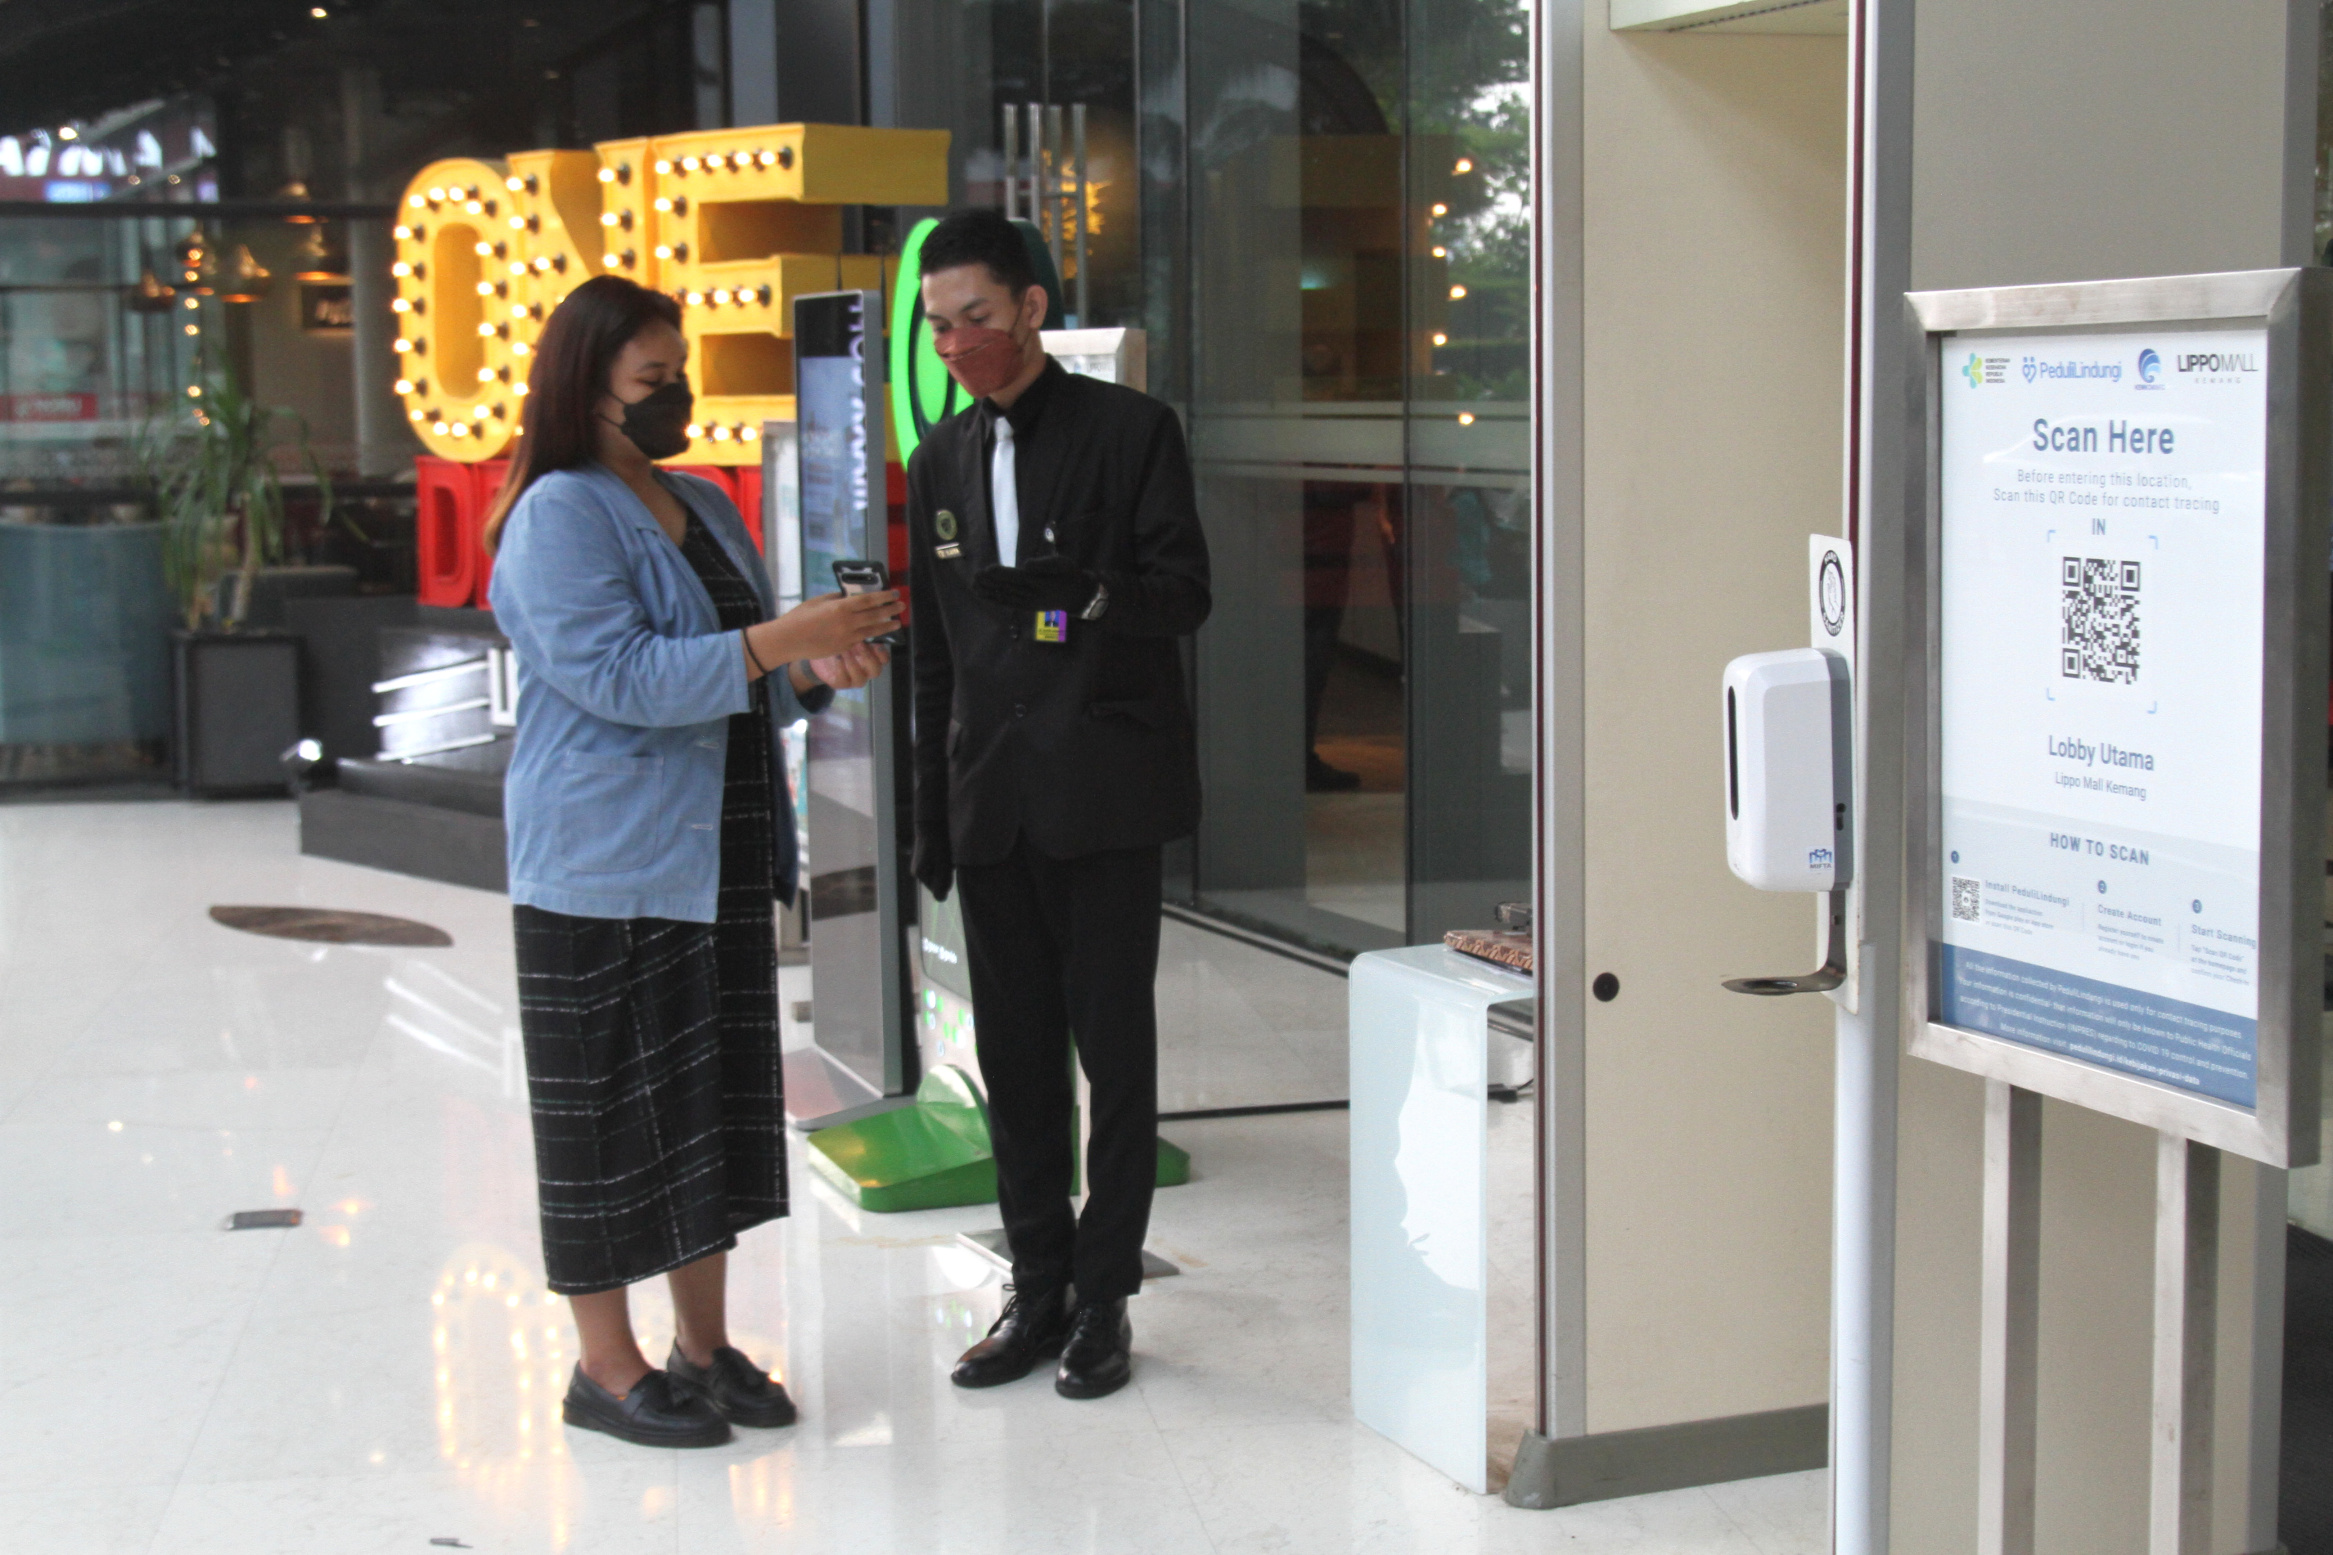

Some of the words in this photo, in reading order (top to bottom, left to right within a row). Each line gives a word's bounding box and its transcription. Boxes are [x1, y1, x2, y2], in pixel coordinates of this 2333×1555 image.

[393, 122, 812, 465] ONE
[2040, 361, 2122, 383] PeduliLindungi
[2033, 418, 2098, 452] Scan
[2109, 420, 2174, 454] Here
[2018, 469, 2054, 484] Before
[2058, 471, 2106, 488] entering
[2110, 473, 2132, 486] this
[2137, 473, 2192, 490] location,
[1994, 488, 2020, 502] Scan
[2024, 490, 2045, 503] this
[2050, 490, 2064, 505] QR
[2069, 492, 2098, 506] Code
[2102, 492, 2119, 507] for
[2124, 495, 2170, 509] contact
[2174, 496, 2220, 514] tracing
[2092, 518, 2106, 536] IN
[2048, 735, 2096, 767] Lobby
[2100, 742, 2154, 771] Utama
[2055, 772, 2080, 789] Lippo
[2084, 776, 2104, 792] Mall
[2106, 780, 2147, 802] Kemang
[2050, 832, 2081, 852] HOW
[2086, 840, 2104, 856] TO
[2110, 844, 2149, 866] SCAN
[1985, 880, 2010, 894] Install
[2012, 884, 2070, 908] PeduliLindungi
[2098, 904, 2125, 918] Create
[2128, 911, 2162, 926] Account
[2192, 924, 2214, 938] Start
[2216, 930, 2257, 950] Scanning
[2112, 999, 2128, 1009] used
[2130, 1004, 2143, 1014] only
[2146, 1007, 2155, 1016] for
[2157, 1011, 2182, 1023] contact
[2184, 1017, 2207, 1031] tracing
[2209, 1024, 2242, 1039] purposes
[2117, 1019, 2130, 1030] only
[2132, 1022, 2140, 1031] be
[2143, 1025, 2165, 1037] known
[2166, 1031, 2173, 1039] to
[2175, 1033, 2196, 1045] Public
[2198, 1039, 2220, 1052] Health
[2137, 1042, 2159, 1054] COVID
[2161, 1048, 2169, 1056] 19
[2171, 1051, 2194, 1063] control
[2196, 1058, 2209, 1068] and
